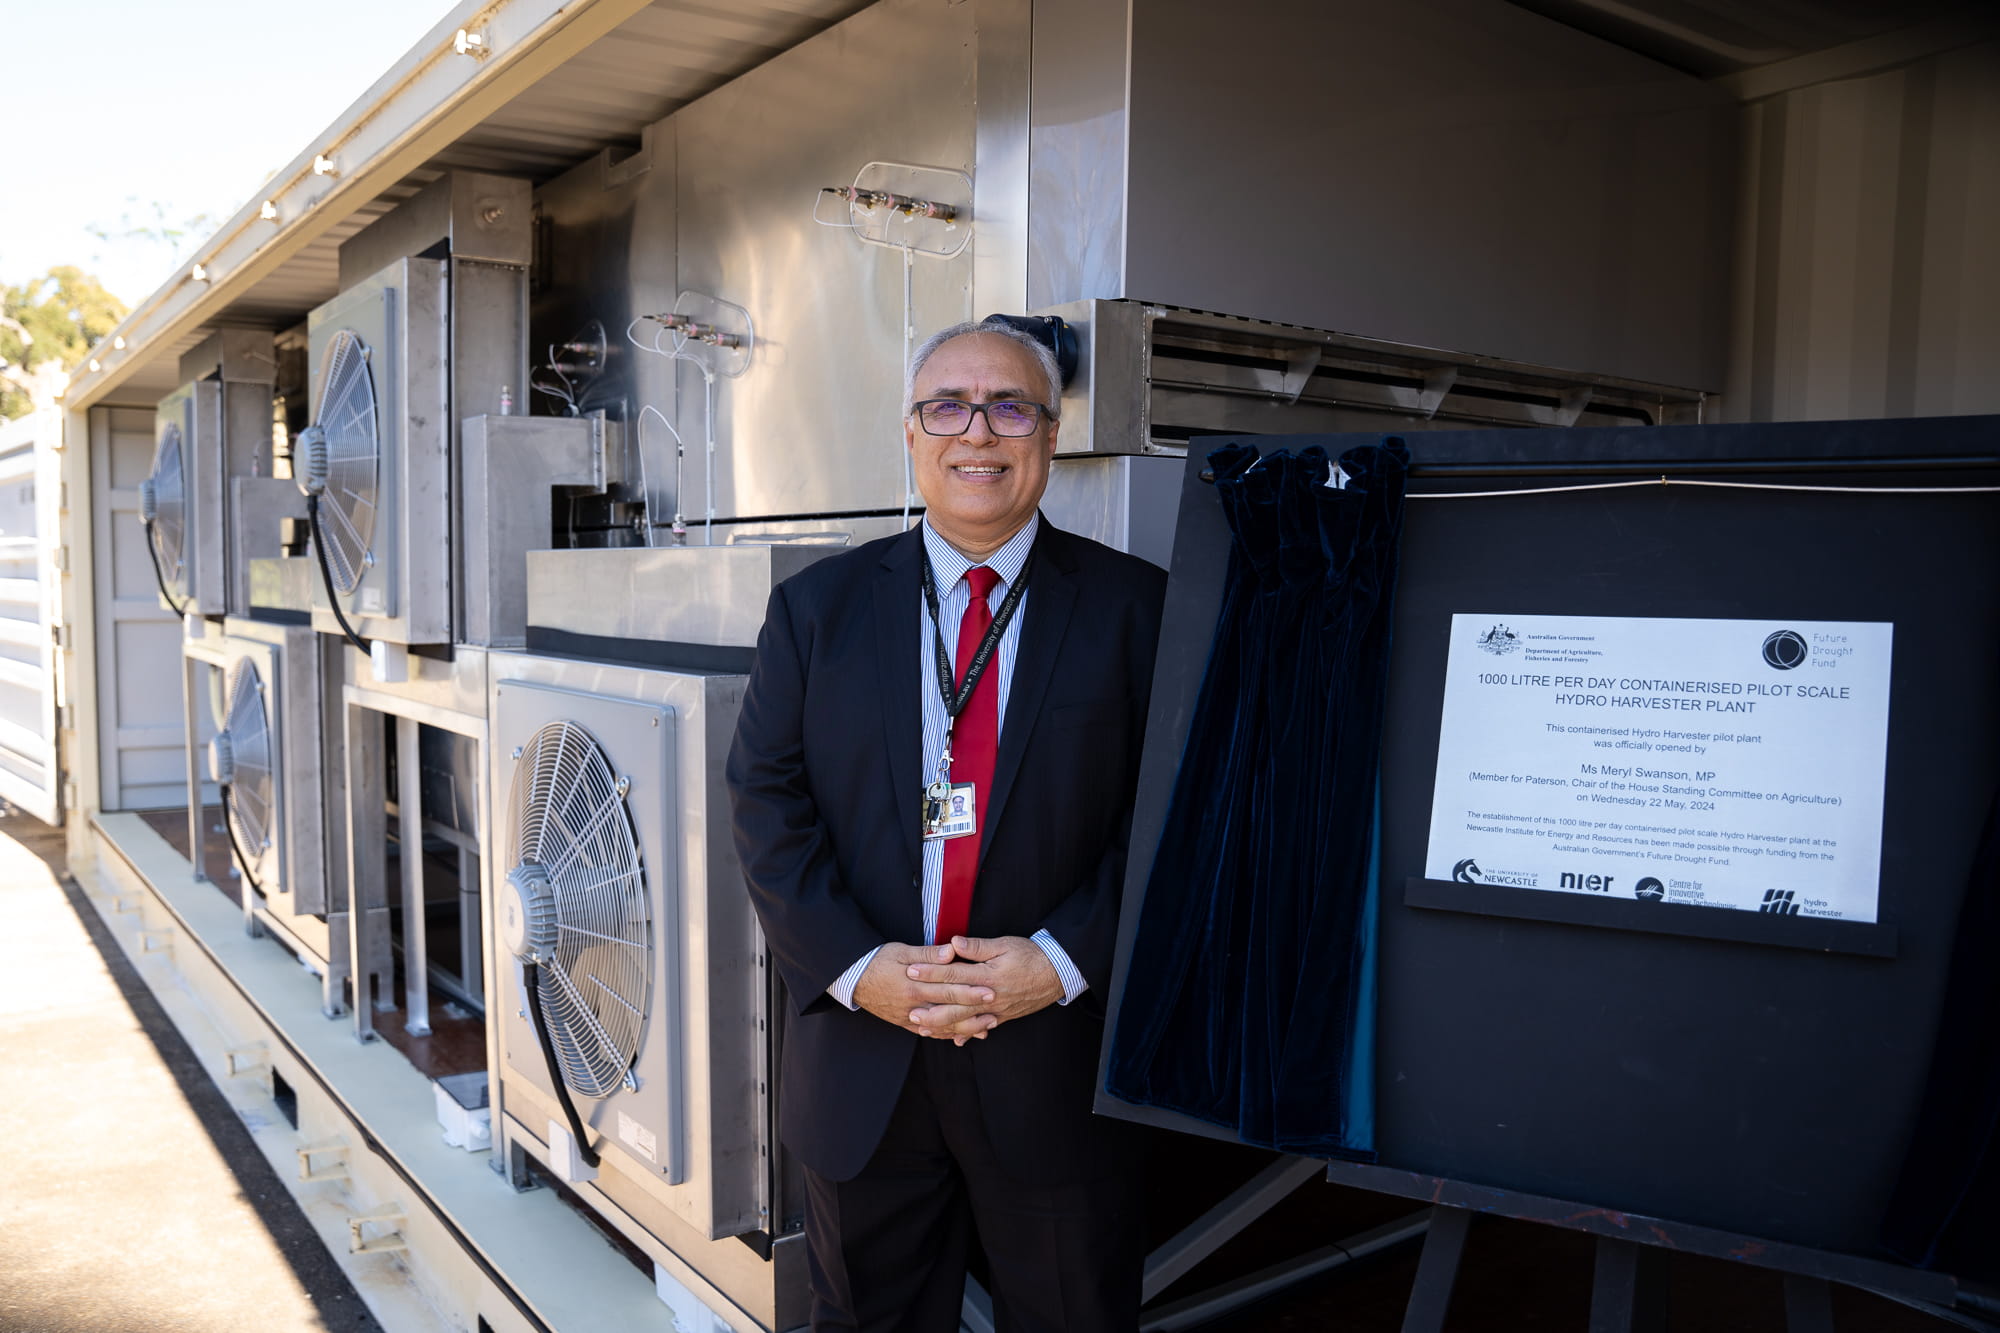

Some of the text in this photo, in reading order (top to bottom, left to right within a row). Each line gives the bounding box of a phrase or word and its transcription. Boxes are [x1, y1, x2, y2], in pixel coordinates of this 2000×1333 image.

[969, 597, 1015, 676] The University of Newcastle
[1813, 632, 1847, 643] Future
[1525, 647, 1560, 655] Department
[1812, 645, 1853, 658] Drought
[1563, 656, 1589, 664] Forestry
[1811, 657, 1836, 668] Fund
[1478, 673, 1850, 699] 1000 LITRE PER DAY CONTAINERISED PILOT SCALE
[1555, 693, 1756, 713] HYDRO HARVESTER PLANT
[1545, 723, 1761, 744] This containerised Hydro Harvester pilot plant
[1593, 739, 1706, 755] was officially opened by
[1580, 763, 1716, 782] Ms Meryl Swanson, MP
[1468, 771, 1842, 807] (Member for Paterson, Chair of the House Standing Committee on Agriculture)
[1590, 793, 1647, 808] Wednesday
[1648, 797, 1662, 807] 22
[1689, 800, 1715, 811] 2024
[1467, 810, 1837, 847] The establishment of this 1000 litre per day containerised pilot scale Hydro Harvester plant at the
[1466, 823, 1835, 861] Newcastle Institute for Energy and Resources has been made possible through funding from the
[1551, 843, 1590, 853] Australian
[1591, 846, 1645, 858] Government's
[1646, 850, 1673, 861] Future
[1674, 853, 1707, 865] Drought
[1484, 874, 1538, 887] NEWCASTLE
[1559, 871, 1614, 892] nier
[1668, 878, 1703, 890] Centre for
[1668, 887, 1705, 899] Innovative
[1803, 898, 1828, 907] hydro
[1803, 907, 1843, 917] harvester
